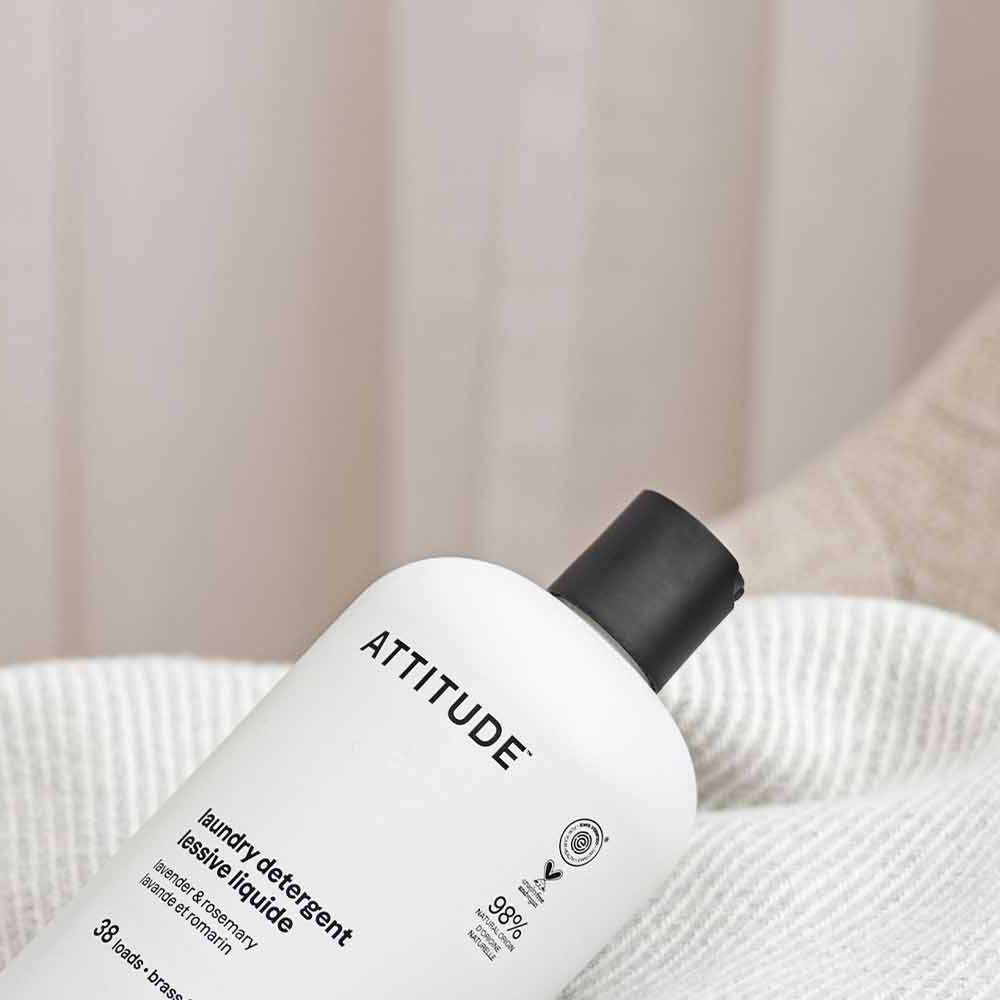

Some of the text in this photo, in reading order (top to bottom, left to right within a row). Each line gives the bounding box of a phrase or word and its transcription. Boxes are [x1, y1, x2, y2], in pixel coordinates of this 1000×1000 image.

[139, 873, 232, 956] lavande et romarin
[153, 859, 258, 951] lavender & rosemary
[177, 829, 294, 934] lessive liquide
[197, 807, 353, 947] laundry detergent
[488, 895, 528, 940] 98%
[94, 918, 120, 944] 38
[112, 938, 144, 970] loads
[475, 907, 501, 936] NATURAL
